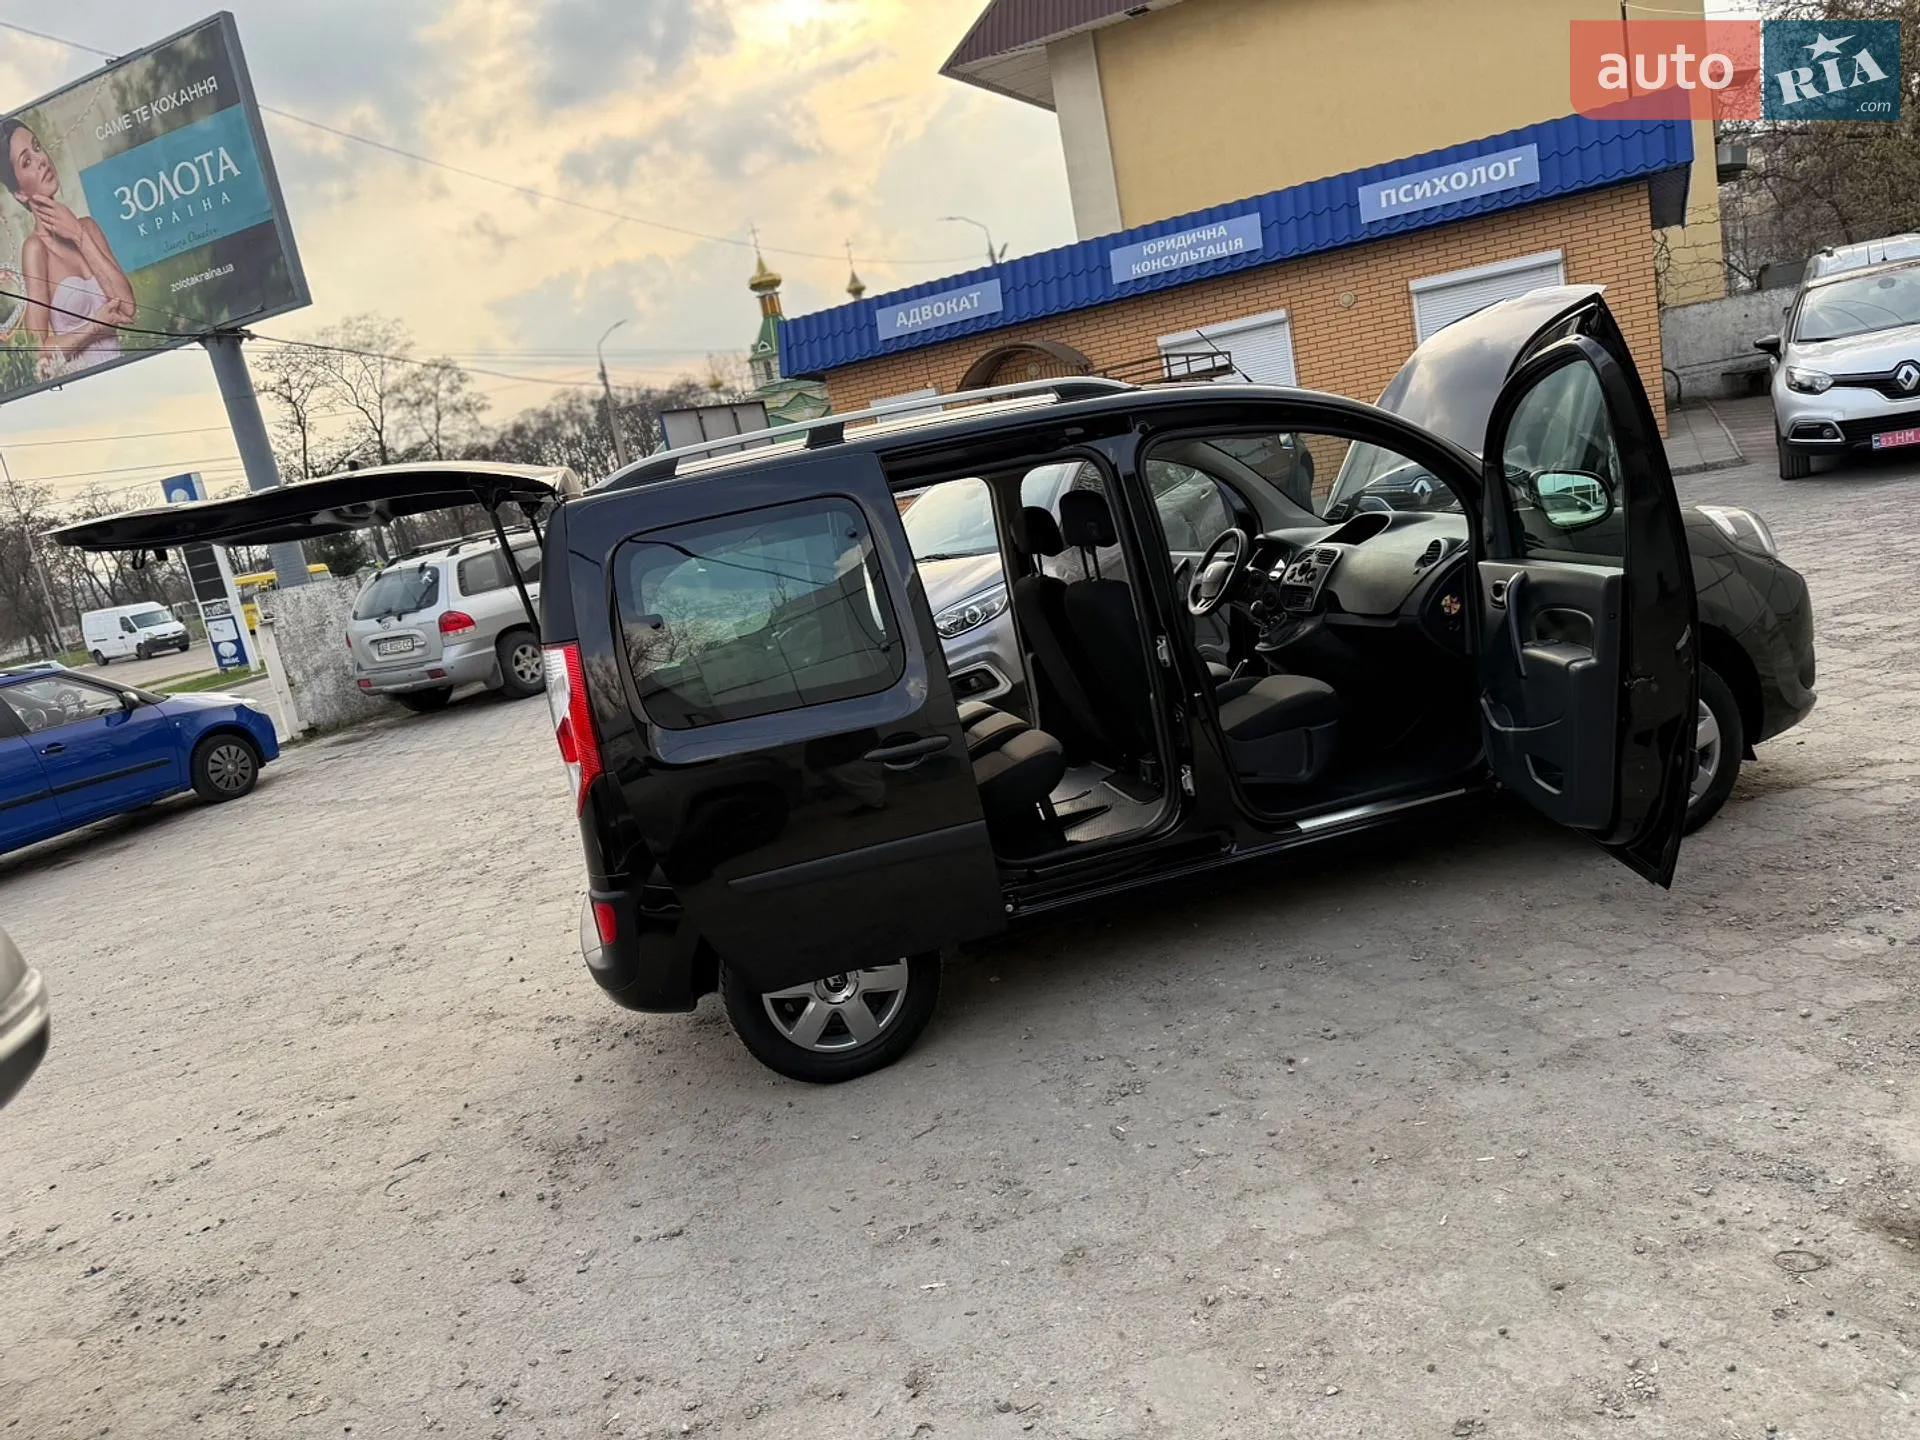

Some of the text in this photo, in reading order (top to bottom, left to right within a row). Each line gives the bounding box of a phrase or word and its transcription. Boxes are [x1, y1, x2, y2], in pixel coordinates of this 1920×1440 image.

[95, 75, 219, 141] САМЕ ТЕ КОХАННЯ
[113, 146, 242, 221] ЗОЛОТА
[1379, 155, 1523, 208] ПСИХОЛОГ
[1131, 236, 1244, 275] КОНСУЛЬТАЦІЯ
[1142, 224, 1228, 257] ЮРИДИЧНА
[169, 263, 235, 293] zolotakraina.ua
[895, 290, 981, 329] АДВОКАТ
